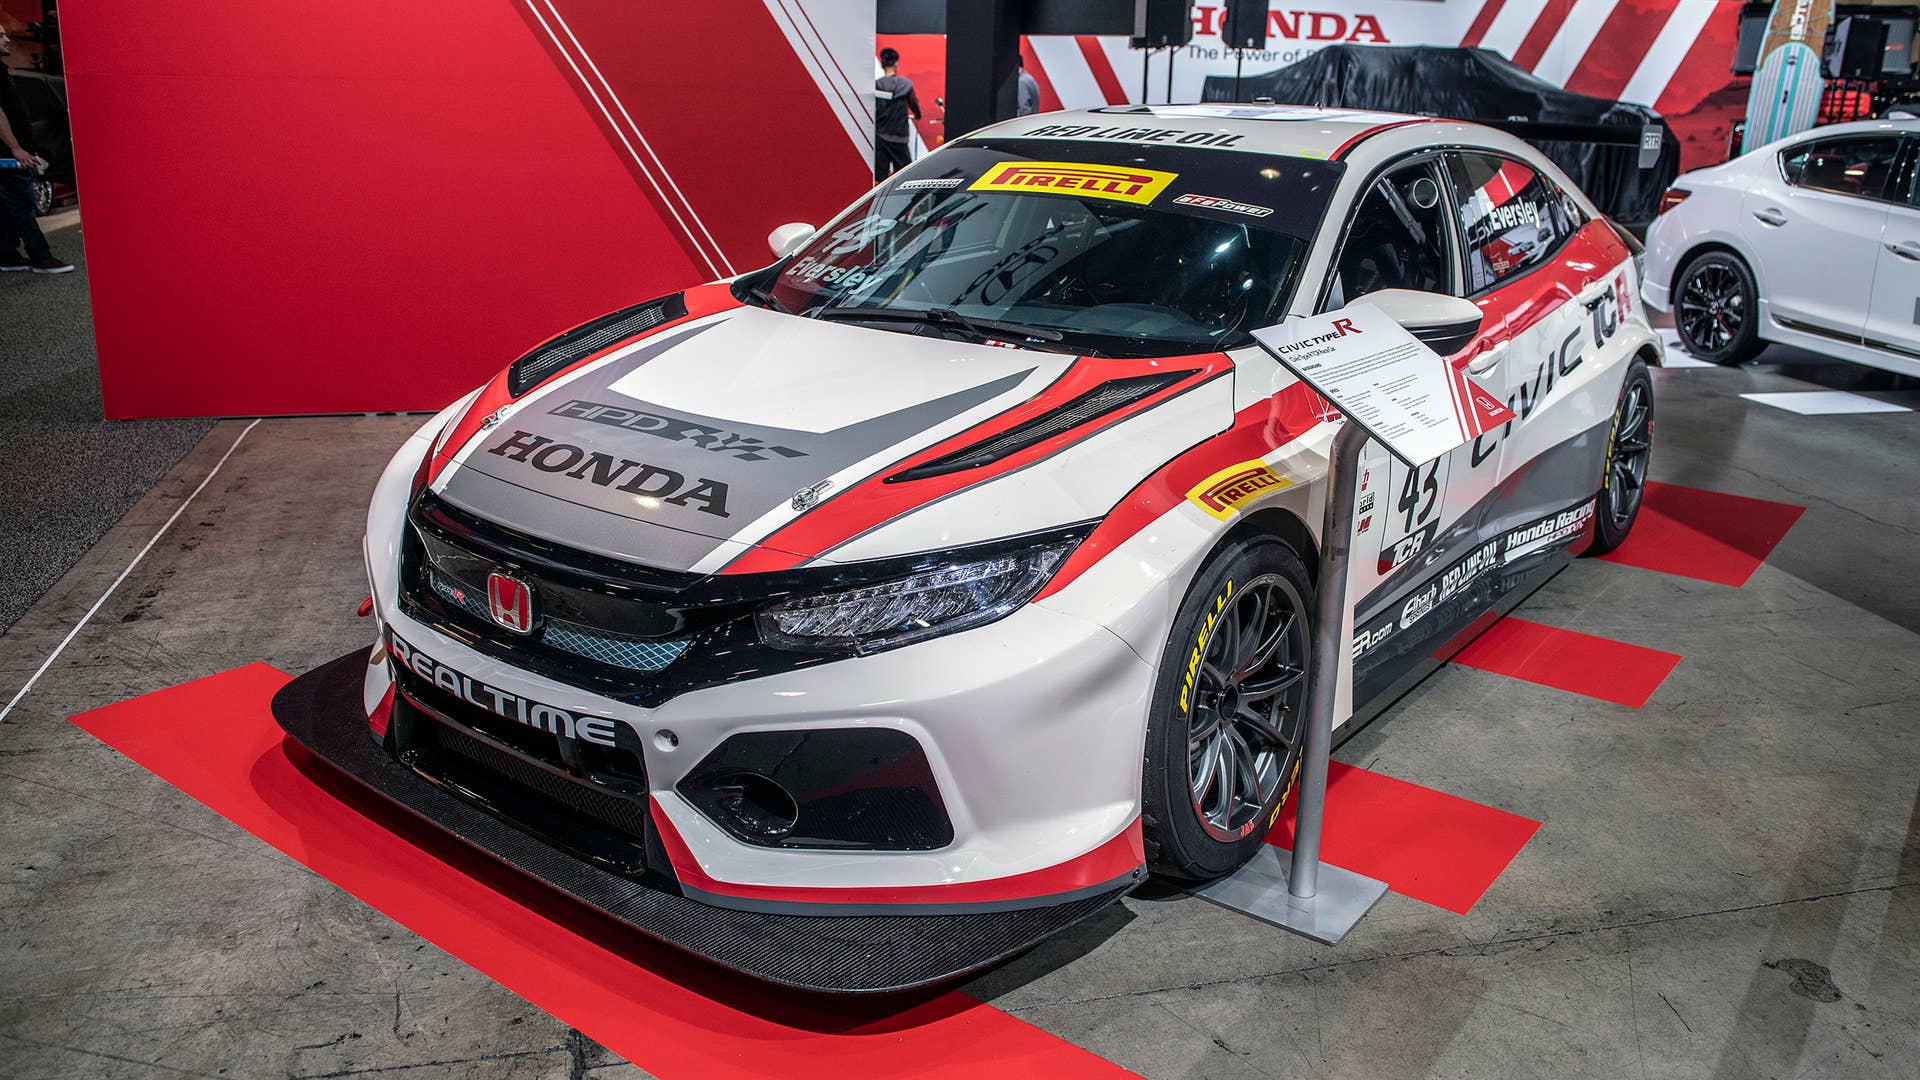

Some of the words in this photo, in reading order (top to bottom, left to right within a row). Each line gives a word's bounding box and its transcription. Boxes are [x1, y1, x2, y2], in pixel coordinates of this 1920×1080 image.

[1188, 45, 1218, 61] The
[1223, 48, 1277, 62] Power
[1283, 49, 1301, 63] of
[1023, 125, 1101, 138] RED
[1088, 127, 1185, 142] LINE
[1176, 132, 1245, 147] OIL
[990, 166, 1154, 196] PIRELLI
[1490, 195, 1540, 230] Eversley
[785, 255, 884, 295] Eversley
[1586, 270, 1632, 350] TCR
[1278, 339, 1314, 354] CIVIC
[1311, 331, 1341, 345] TYPE
[1331, 317, 1363, 337] R
[557, 400, 669, 431] HPD
[487, 430, 731, 519] HONDA
[1198, 466, 1281, 513] PIRELLI
[1397, 456, 1439, 533] 43
[1504, 518, 1556, 552] Honda
[1554, 498, 1597, 530] Racing
[1391, 529, 1426, 568] TCR
[1439, 566, 1461, 601] RED
[1457, 550, 1482, 586] LINE
[1478, 541, 1497, 570] OIL
[1180, 579, 1234, 714] PIRELLI
[391, 631, 616, 747] REALTIME
